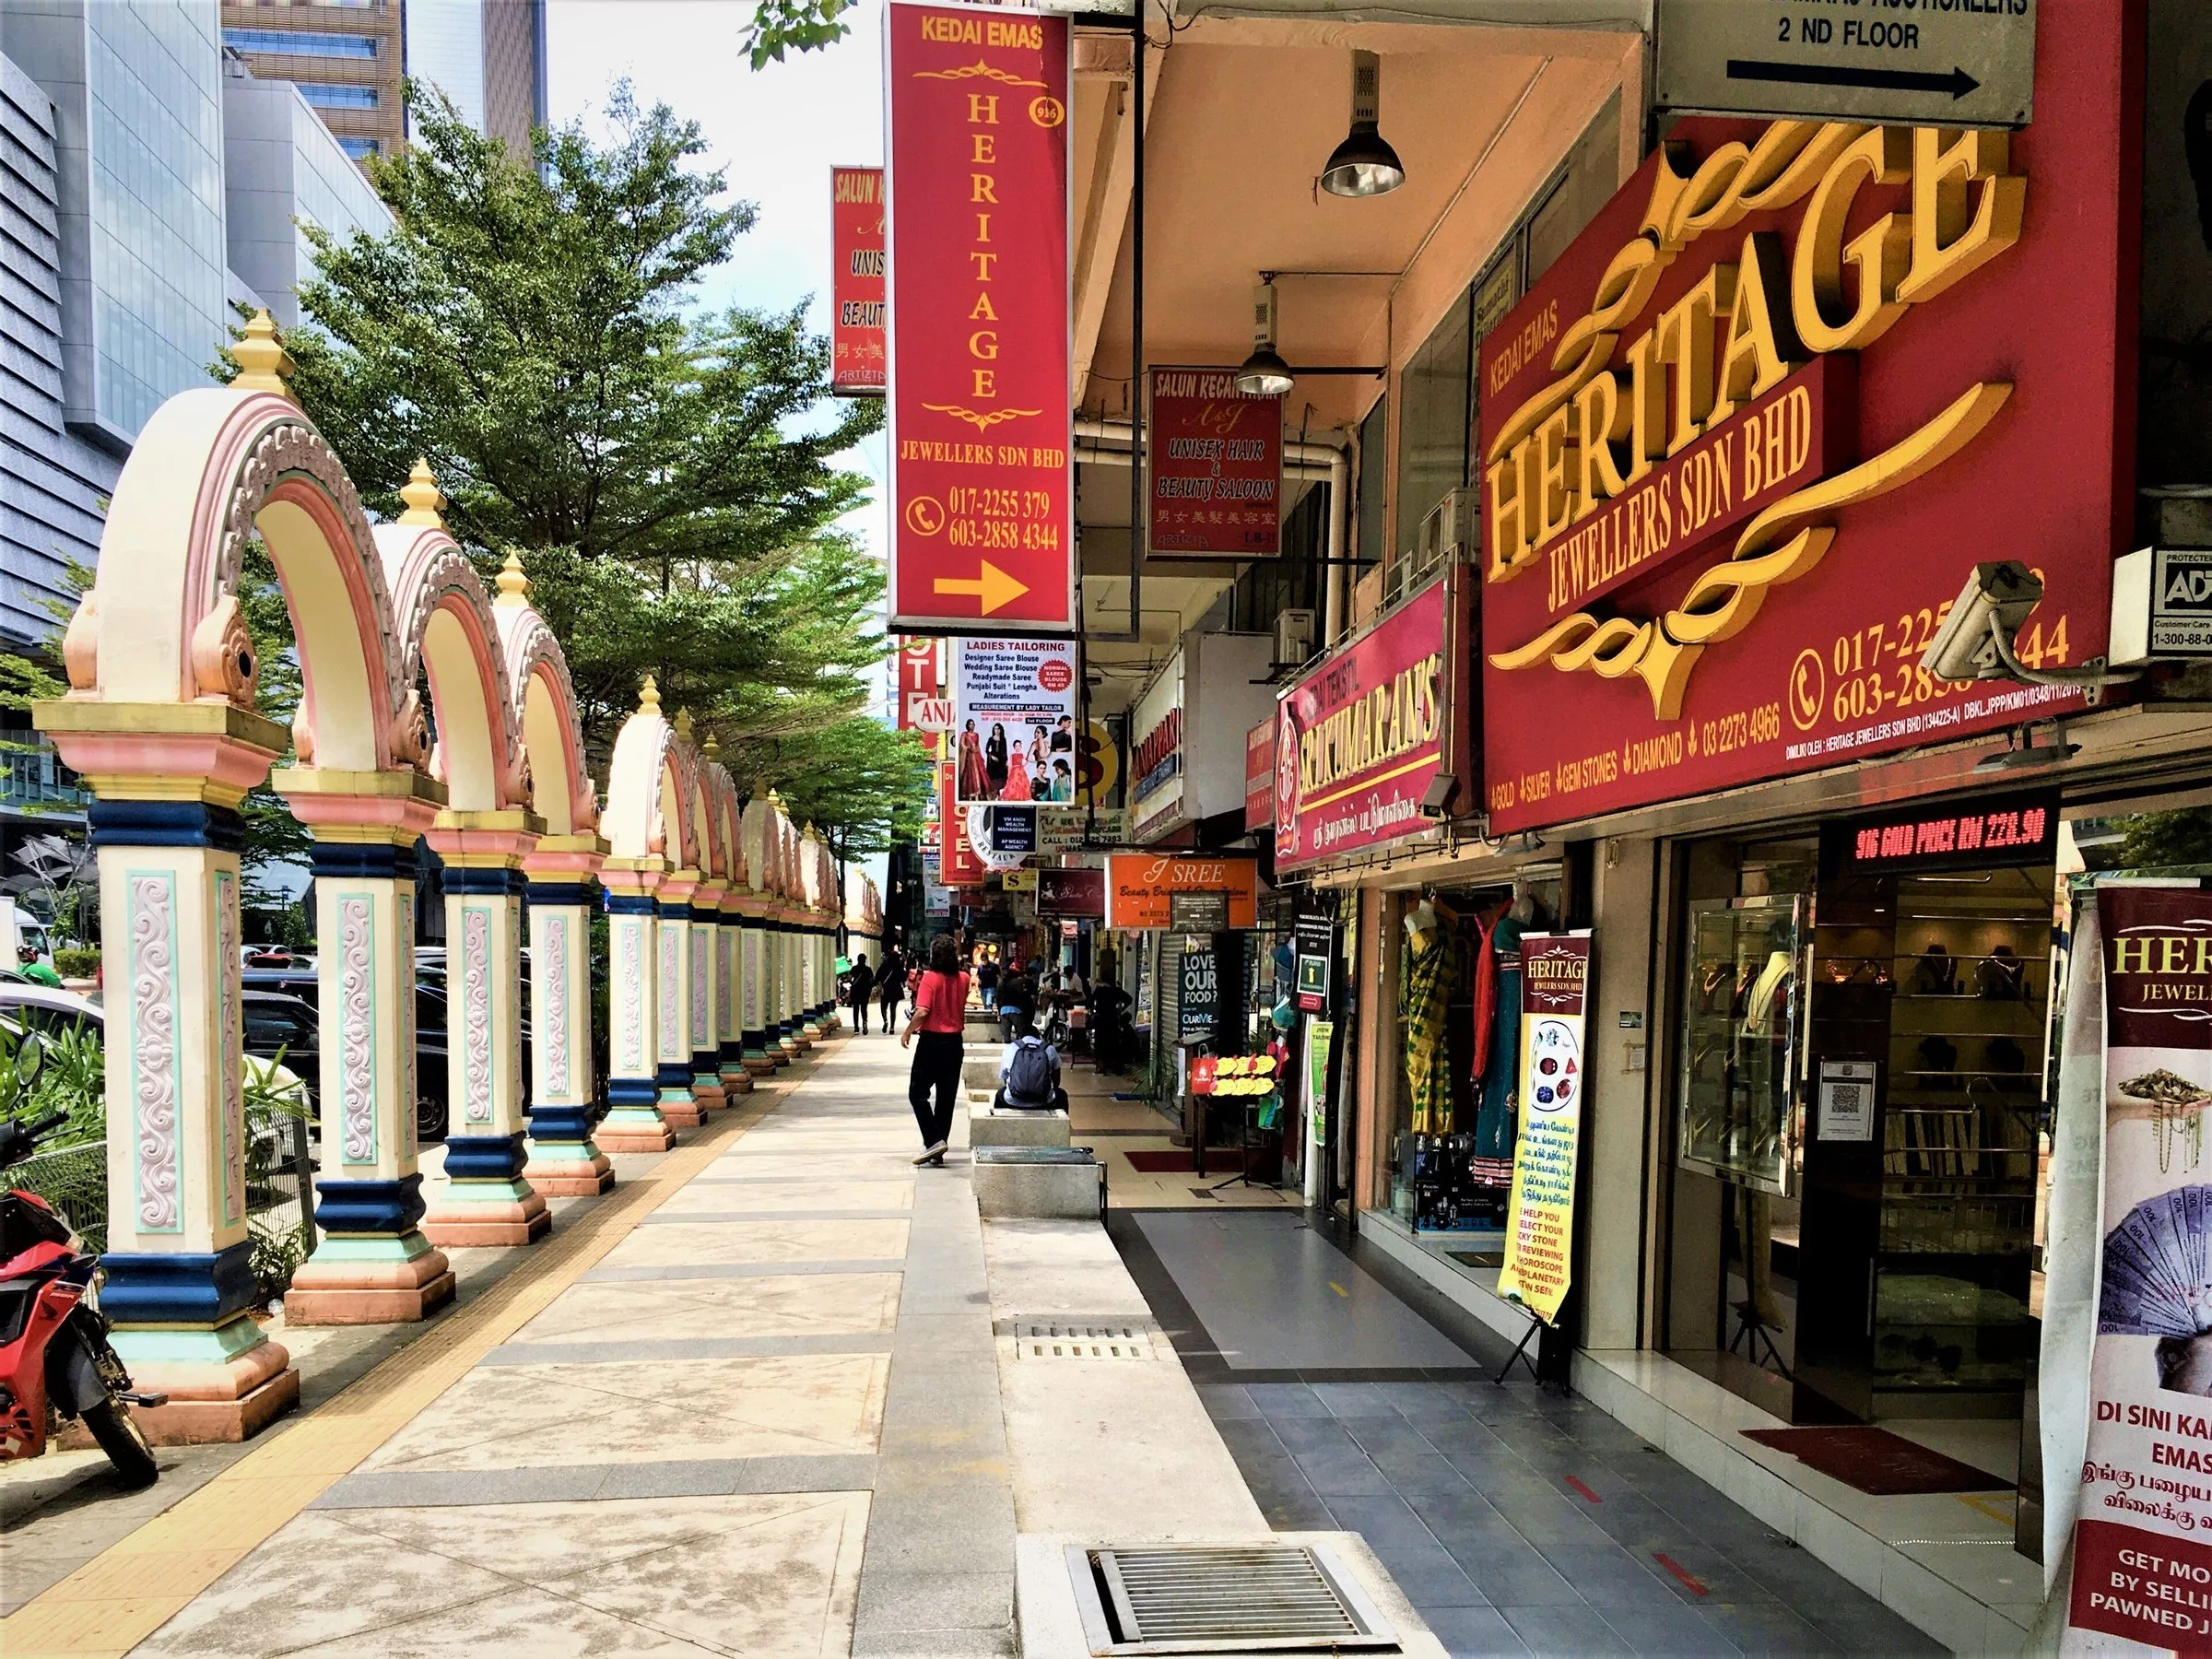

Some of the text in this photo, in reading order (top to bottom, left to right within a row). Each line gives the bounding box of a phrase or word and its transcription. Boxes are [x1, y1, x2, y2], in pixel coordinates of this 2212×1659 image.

[922, 16, 1043, 50] KEDAI EMAS
[1778, 18, 1919, 49] 2 ND FLOOR
[836, 173, 874, 204] SALUN
[967, 93, 1000, 399] HERITAGE
[841, 300, 885, 332] BEAUT
[1486, 125, 2009, 582] HERITAGE
[1490, 334, 1522, 398] KEDAI
[1524, 298, 1558, 365] EMAS
[1156, 373, 1196, 398] SALUN
[901, 441, 1065, 468] JEWELLERS SDN BHD
[1169, 438, 1265, 462] UNISEX HAIR
[1211, 461, 1220, 477] &
[1157, 477, 1275, 502] BEAUTY SALOON
[1547, 383, 1811, 613] JEWELLERS SDN BHD
[949, 486, 1050, 519] 017-2255 379
[949, 518, 1058, 551] 603-2858 4344
[2166, 554, 2212, 562] PROTECTE
[964, 653, 994, 663] Designer
[967, 641, 1065, 652] LADIES TAILORING
[964, 664, 993, 672] Wedding
[972, 673, 1011, 682] Readymade
[966, 683, 991, 691] Punjabi
[1013, 684, 1037, 692] Lengha
[922, 701, 956, 727] ANJ
[1806, 738, 1822, 757] OLEH
[1826, 734, 1854, 754] HERITAGE
[1854, 723, 1891, 748] JEWELLERS
[1892, 720, 1907, 737] SDN
[1907, 717, 1922, 735] BHD
[1496, 701, 1780, 810] GOLD SILVER GEM STONES DIAMOND 03 2273 4966
[1070, 836, 1084, 844] 012
[1856, 829, 1879, 859] 916
[1880, 825, 1914, 857] GOLD
[1916, 818, 1956, 854] PRICE
[1958, 816, 1984, 850] RM
[1171, 864, 1226, 883] SREE
[1120, 885, 1150, 899] Beauty
[1183, 955, 1216, 971] LOVE
[1184, 971, 1218, 991] OUR
[2142, 983, 2212, 1002] JEWEL
[1519, 1219, 1563, 1236] ELECT YOUR
[1524, 1208, 1559, 1223] HELP YOU
[1532, 1234, 1558, 1247] STONE
[1523, 1245, 1563, 1262] REVIEWING
[2097, 1401, 2212, 1441] DI SINI KA
[2118, 1548, 2163, 1573] GET
[2111, 1571, 2212, 1610] BY SELLI
[2090, 1592, 2193, 1631] PAWNED
